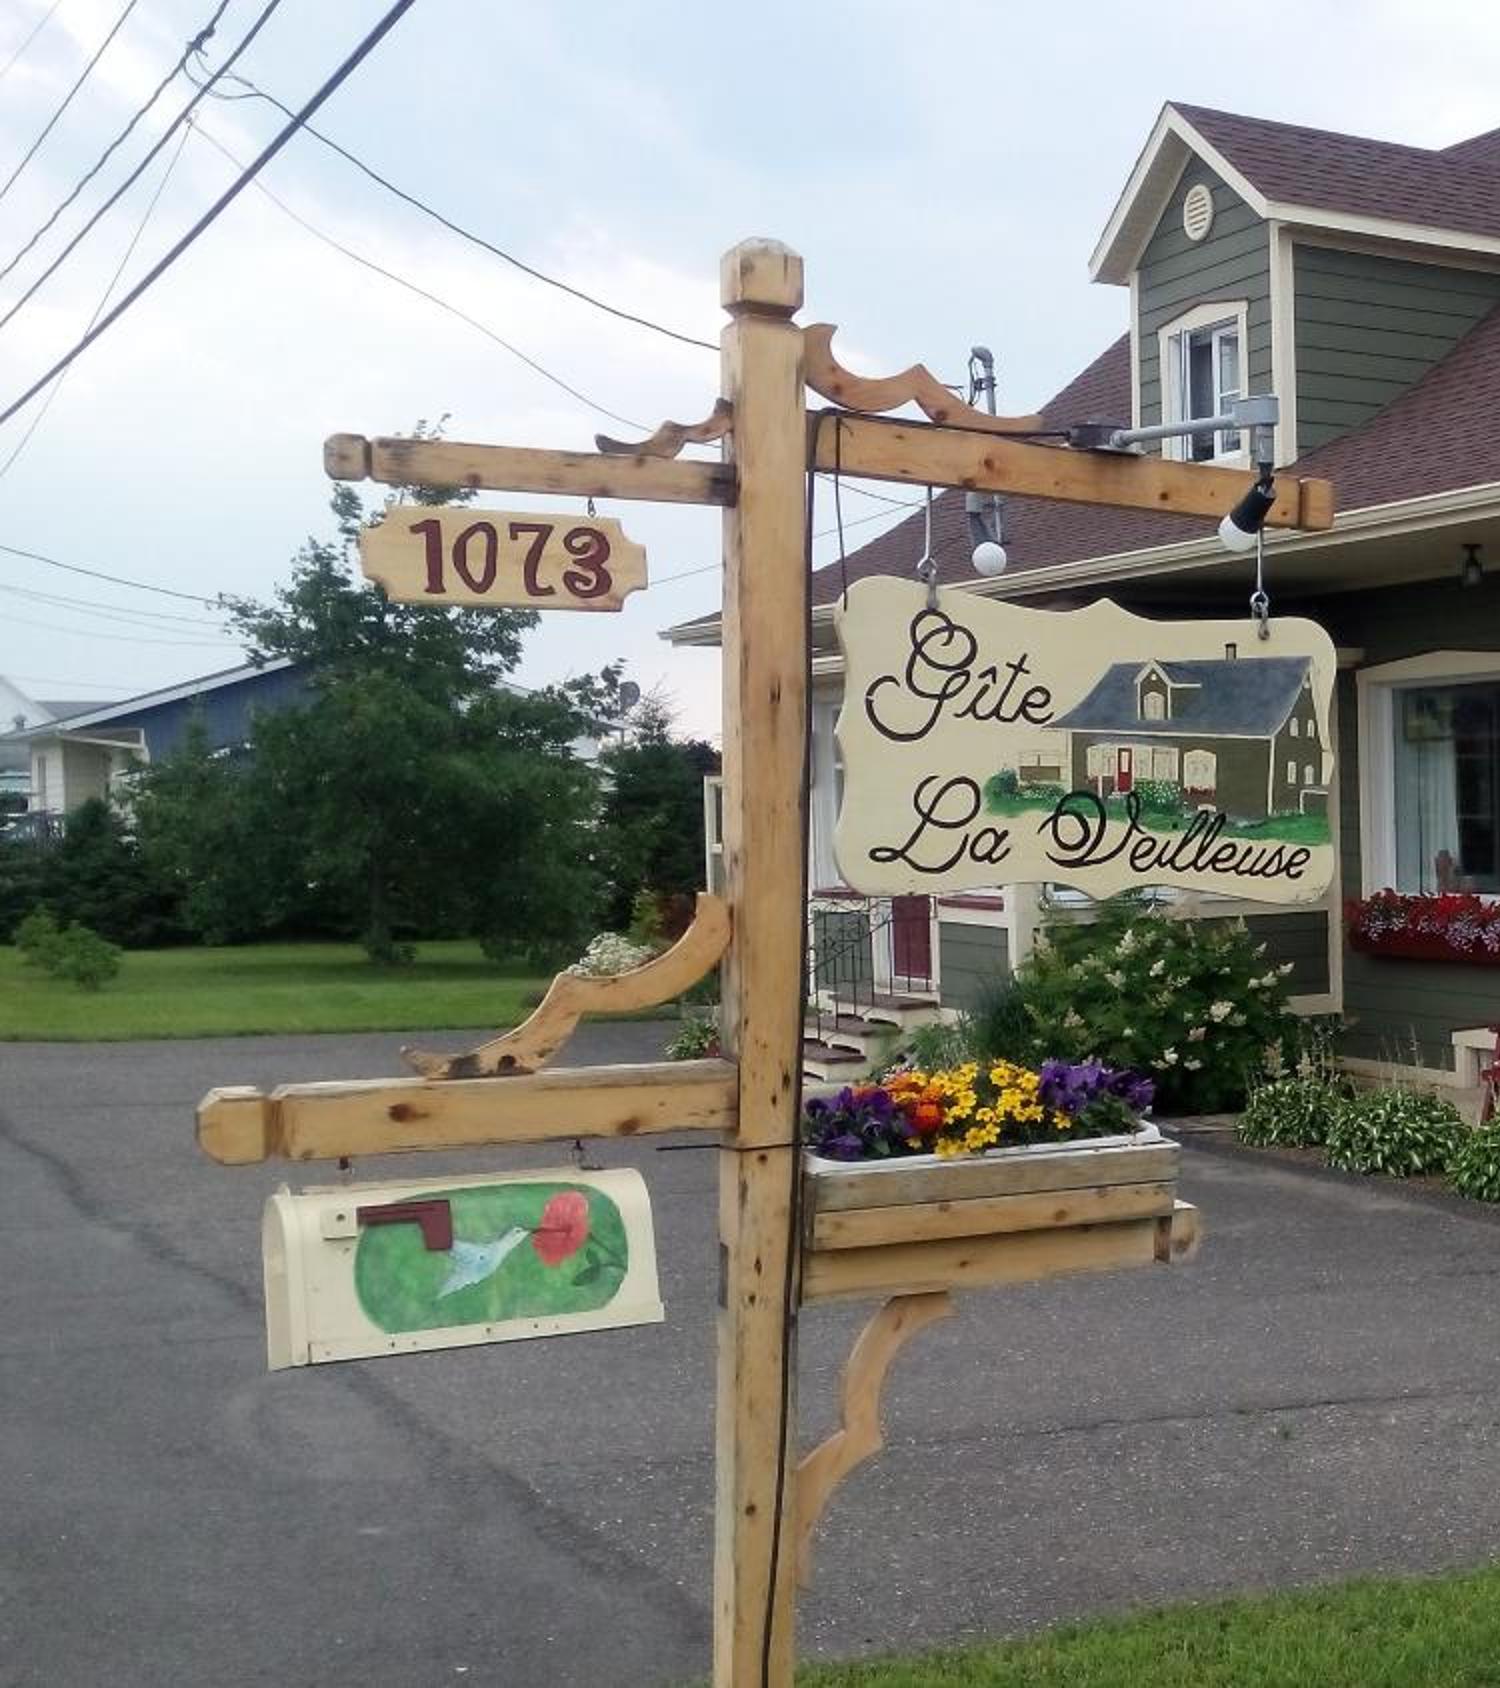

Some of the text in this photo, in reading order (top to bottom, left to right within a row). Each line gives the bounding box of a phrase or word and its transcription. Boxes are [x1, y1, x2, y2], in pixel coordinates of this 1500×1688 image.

[409, 519, 613, 599] 1073
[865, 608, 1055, 742] Gîte
[868, 775, 1312, 879] La Veilleuse
